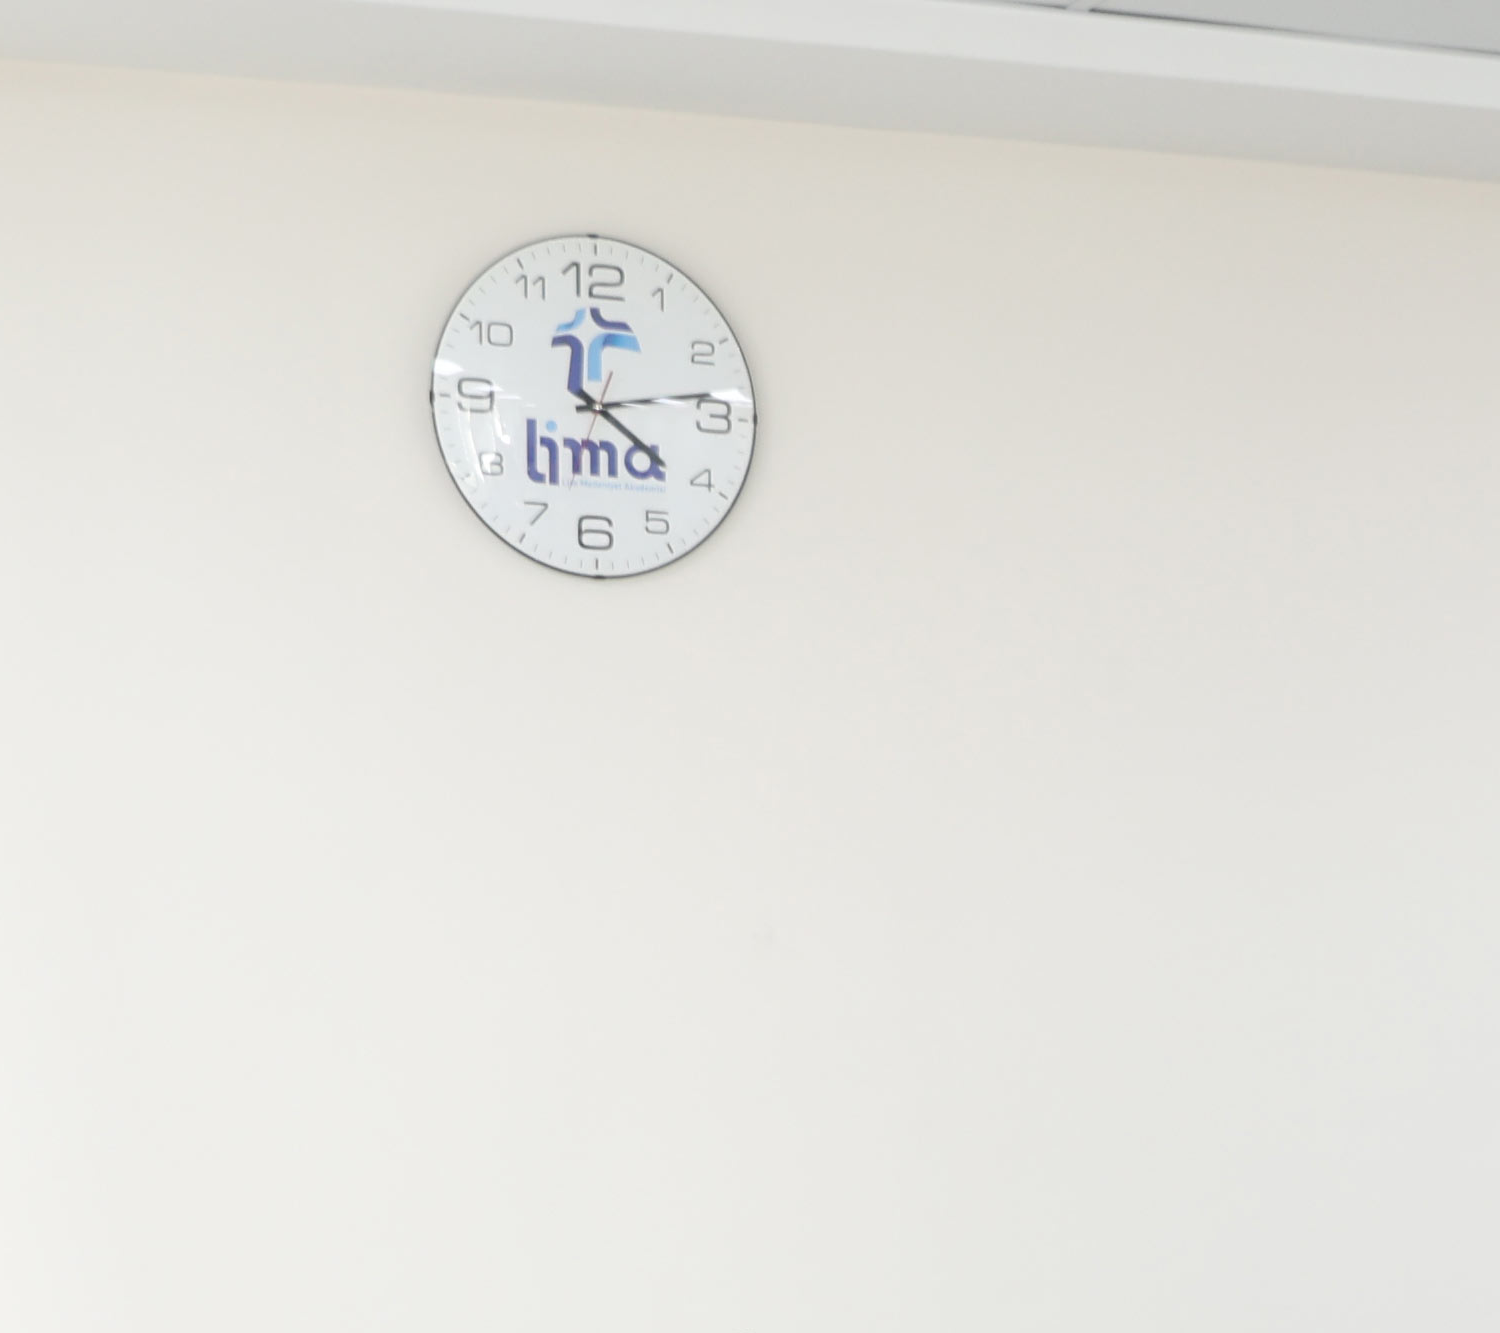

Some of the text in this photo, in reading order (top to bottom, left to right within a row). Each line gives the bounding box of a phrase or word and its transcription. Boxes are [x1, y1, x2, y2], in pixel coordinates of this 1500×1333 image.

[514, 273, 545, 301] 11
[561, 260, 626, 302] 12
[651, 287, 664, 312] 1
[469, 319, 514, 348] 10
[690, 340, 715, 366] 2
[456, 376, 496, 414] 9
[695, 397, 732, 434] 3
[525, 417, 668, 486] lima
[689, 468, 716, 493] 4
[523, 500, 550, 527] 7
[644, 509, 671, 536] 5
[576, 514, 614, 551] 6
